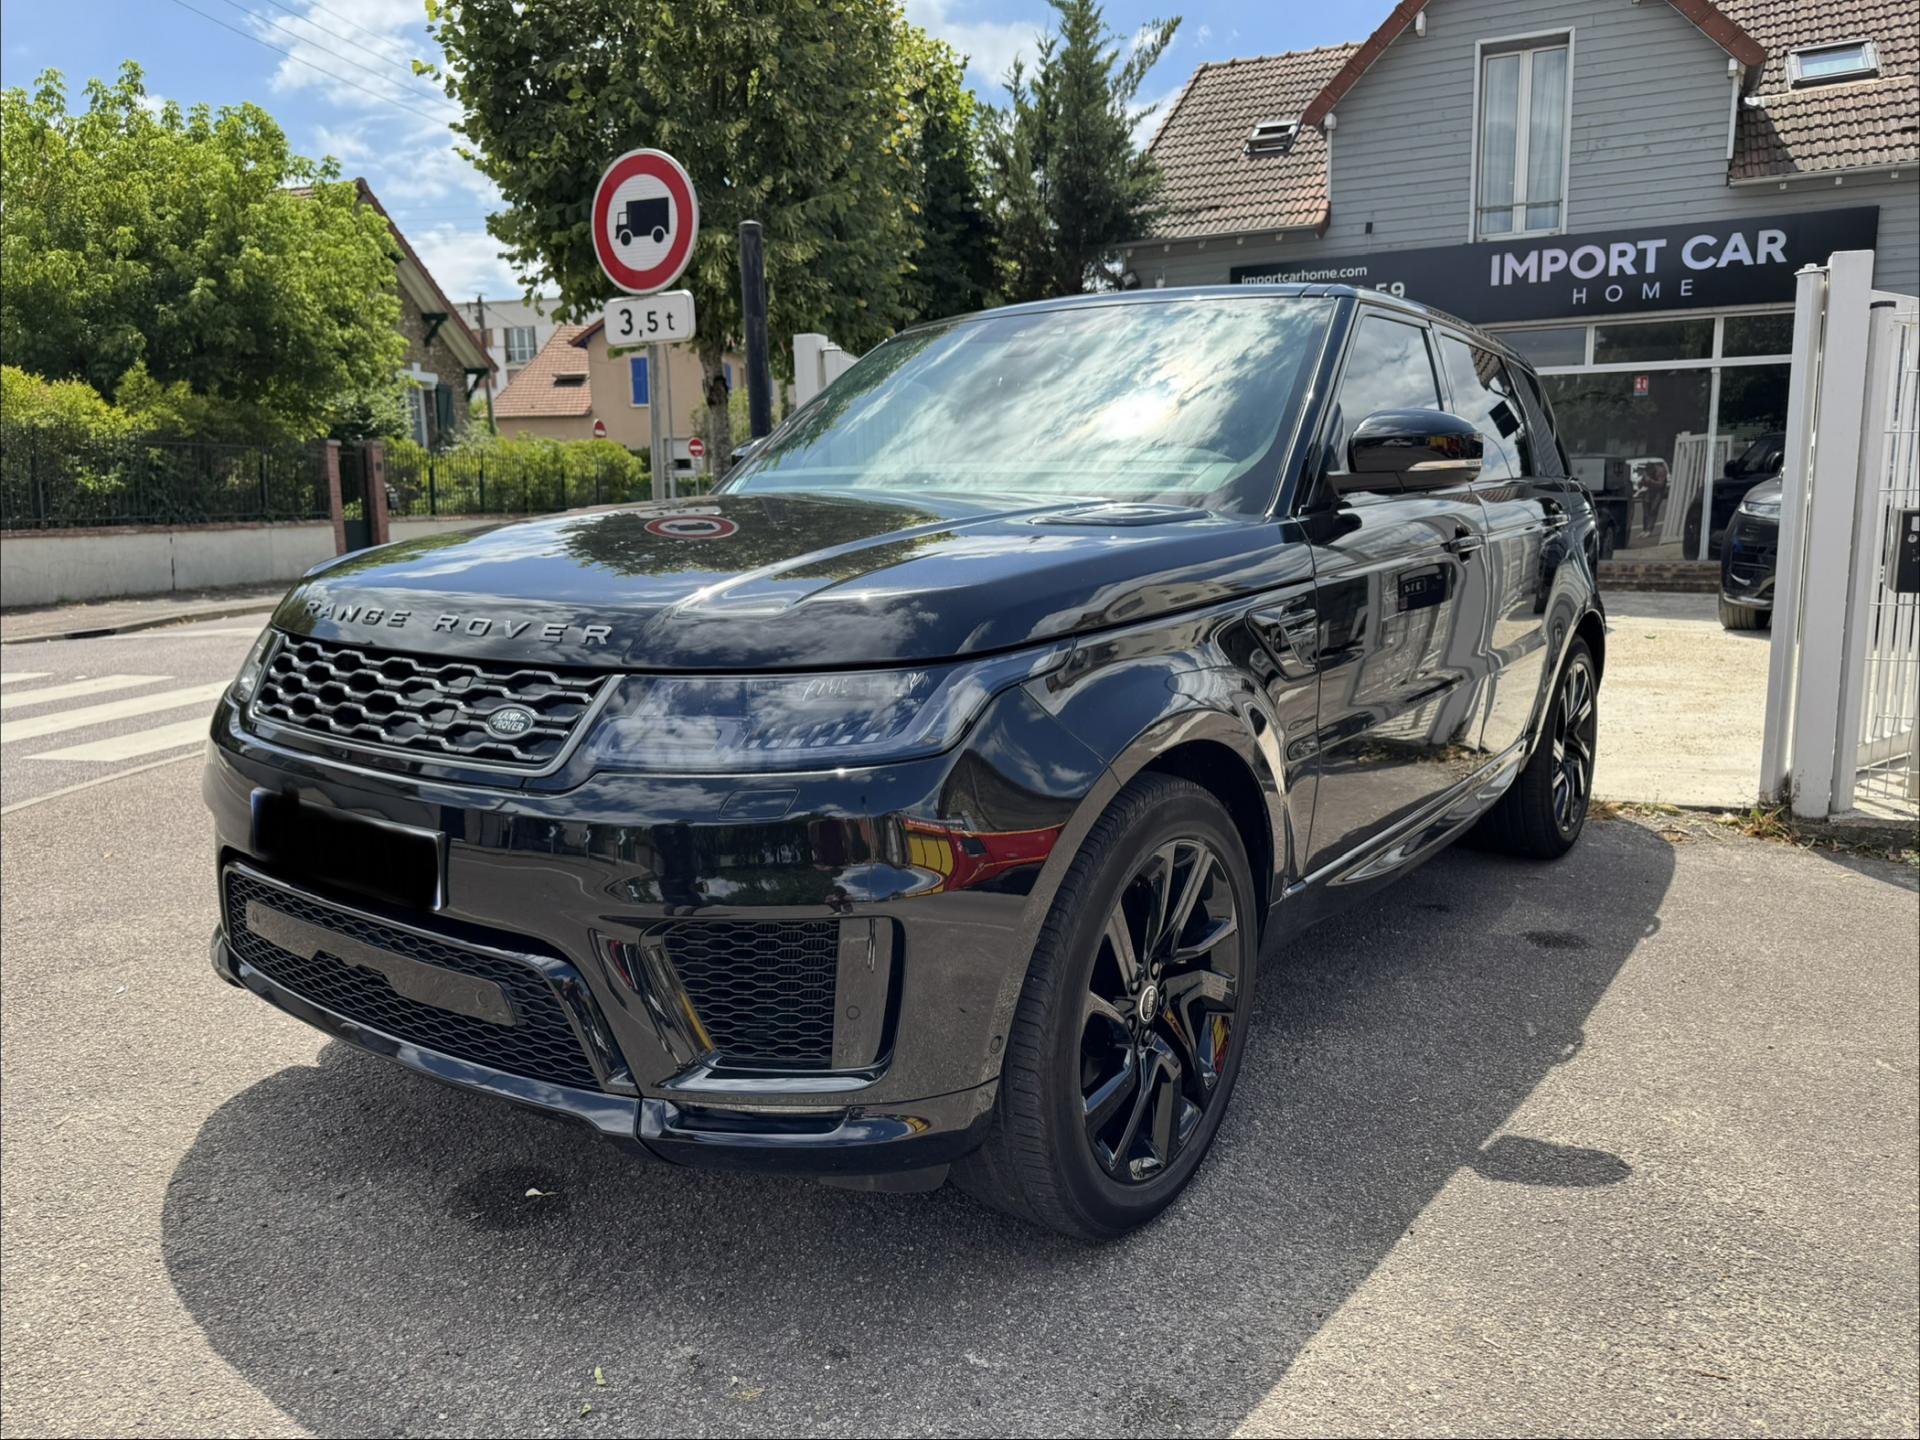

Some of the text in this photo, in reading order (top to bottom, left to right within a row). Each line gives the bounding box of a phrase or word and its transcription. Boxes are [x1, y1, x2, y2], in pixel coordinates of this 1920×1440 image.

[1490, 229, 1788, 287] IMPORT CAR
[1241, 266, 1367, 285] importcarhome.com
[1572, 279, 1694, 305] HOME
[619, 308, 675, 337] 3,5 t
[303, 600, 613, 645] RANGE ROVER
[495, 720, 525, 732] ROVER
[497, 711, 521, 720] LAND
